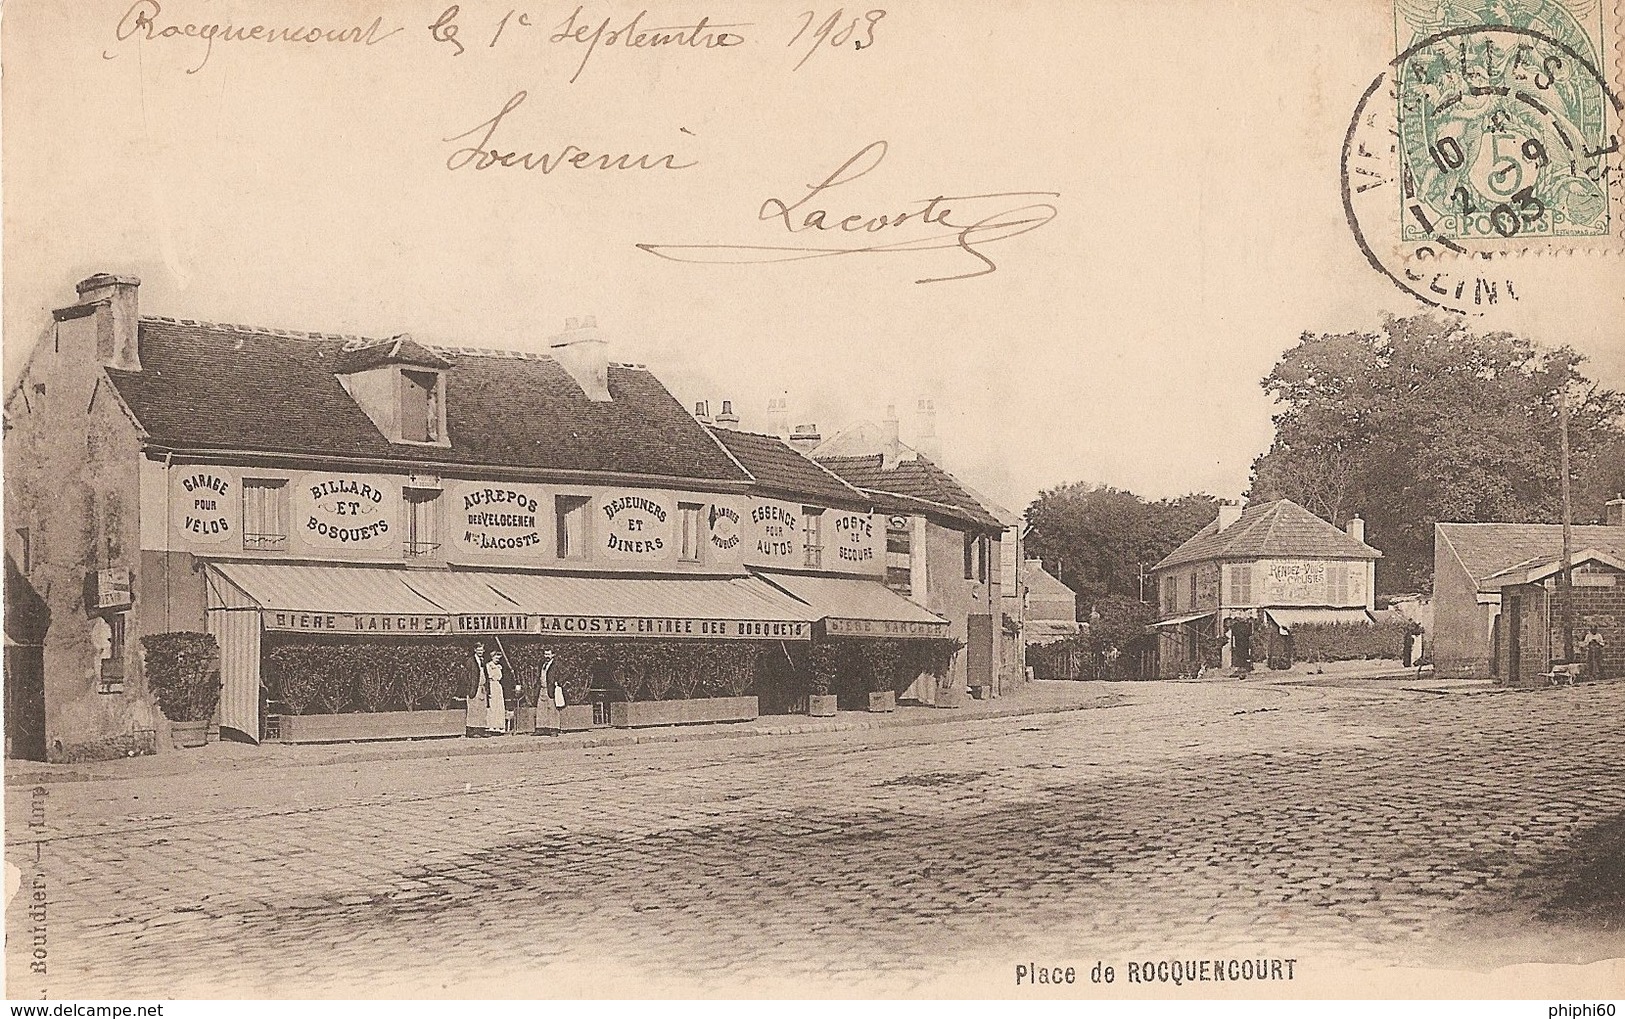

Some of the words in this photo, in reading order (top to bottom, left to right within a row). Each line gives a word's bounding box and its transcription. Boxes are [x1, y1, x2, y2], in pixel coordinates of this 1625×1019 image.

[788, 8, 886, 72] 1903
[442, 90, 700, 175] Souvenir
[1429, 137, 1465, 174] 10
[1487, 134, 1522, 196] 5
[1460, 211, 1550, 236] POSES
[183, 474, 228, 496] GARAGE
[310, 479, 382, 503] BILLARD
[194, 499, 216, 510] POUR
[337, 501, 360, 515] ET
[468, 514, 482, 525] DES
[628, 519, 643, 531] ET
[751, 505, 796, 531] ESSENCE
[835, 516, 872, 538] POSTE
[307, 516, 388, 542] BOSQUETS
[766, 526, 783, 537] POUR
[851, 533, 860, 542] DE
[480, 532, 540, 549] LACOSTE
[607, 533, 663, 553] DINERS
[757, 540, 793, 555] AUTOS
[839, 546, 873, 561] SECOURS
[354, 616, 447, 631] KARCHER
[458, 616, 529, 631] RESTAURANT
[541, 617, 627, 633] LACOSTE
[702, 621, 726, 635] DES
[738, 622, 802, 637] BOSQUETS
[1015, 962, 1077, 985] Place
[1090, 960, 1115, 983] de
[1127, 958, 1298, 986] ROCQUENCOURT
